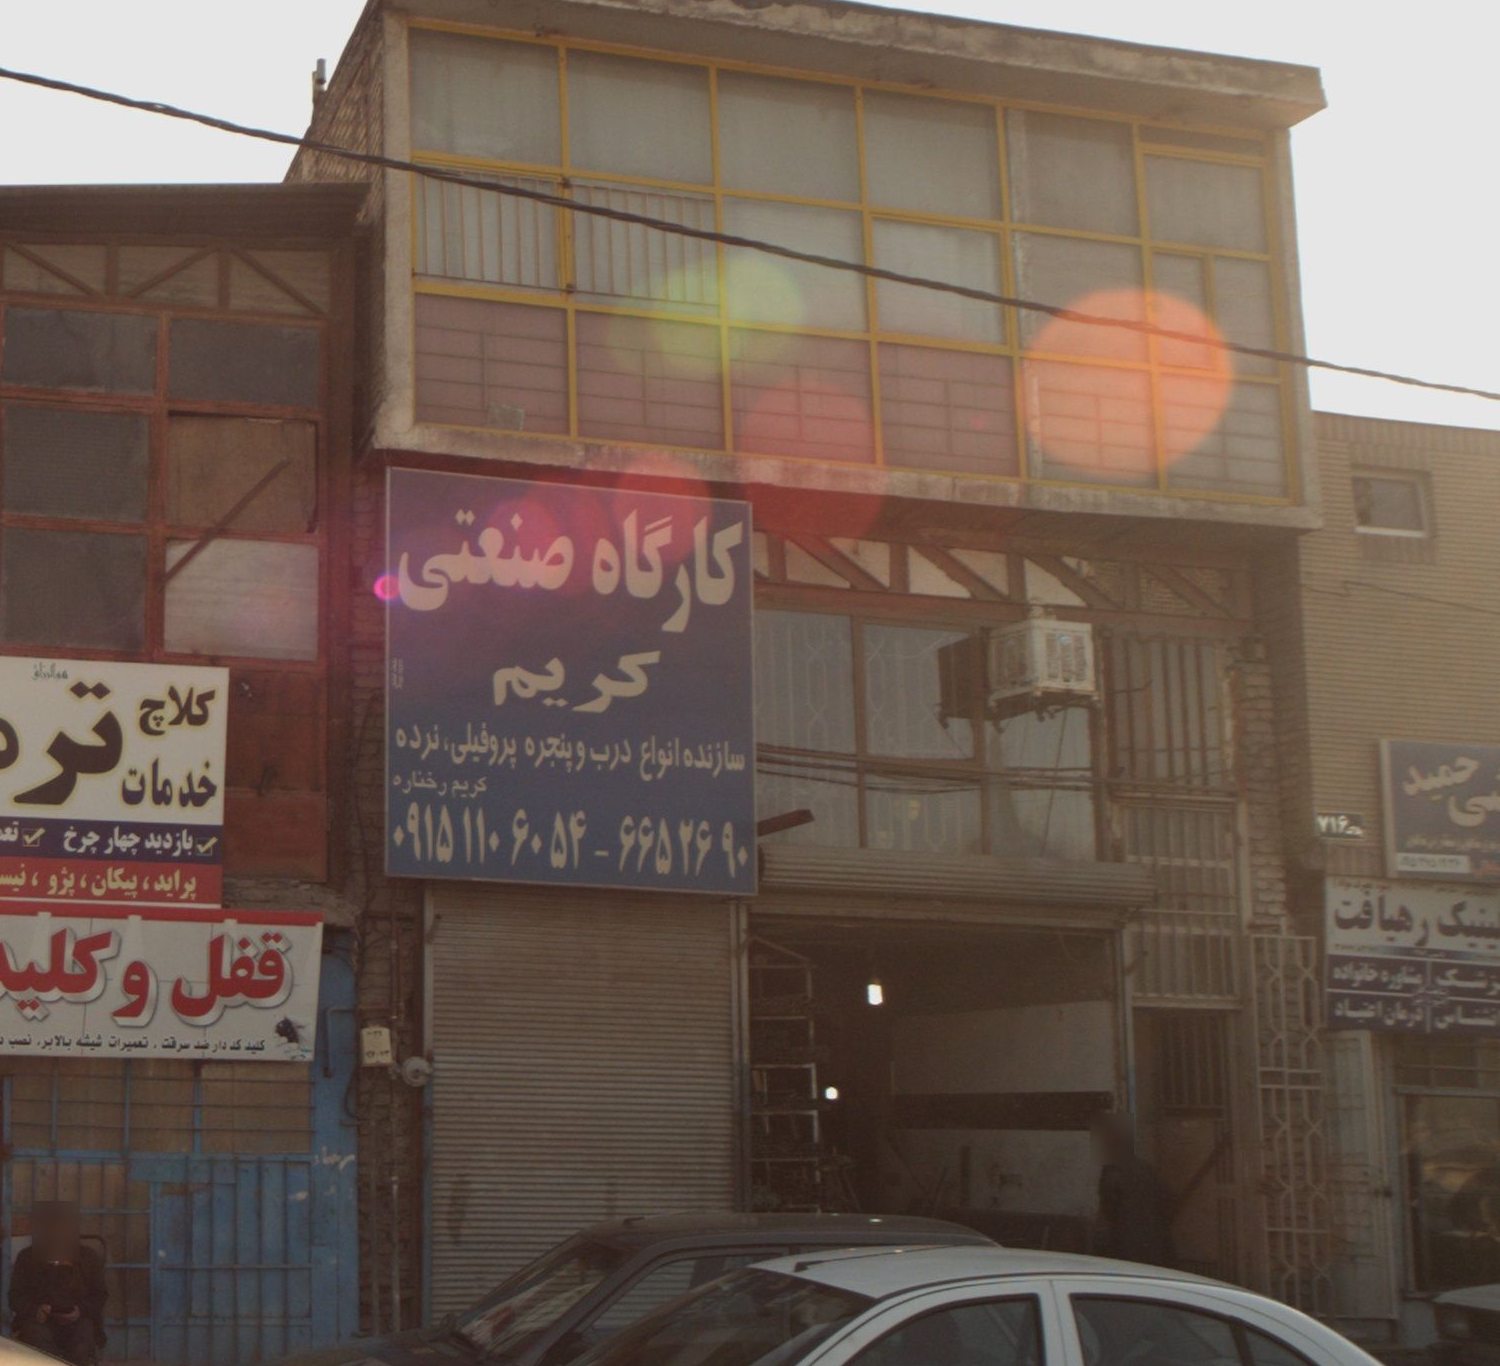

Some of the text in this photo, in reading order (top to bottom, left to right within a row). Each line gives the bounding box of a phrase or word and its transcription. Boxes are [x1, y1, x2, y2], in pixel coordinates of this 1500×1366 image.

[399, 509, 743, 633] کارگاه صنعتی
[492, 650, 661, 714] کریم
[139, 685, 216, 736] کلاچ
[395, 723, 440, 761] نرده
[590, 738, 633, 771] درب
[639, 736, 680, 782] انواع
[682, 738, 746, 778] سازنده
[121, 757, 218, 808] خدمات
[451, 775, 488, 798] کریم
[1401, 754, 1480, 800] حمید
[62, 826, 193, 857] بازدید چهار چرخ
[1334, 889, 1429, 947] رهیافت
[111, 960, 151, 1020] و
[171, 931, 287, 1019] قفل
[7, 1034, 33, 1048] نصب
[75, 1033, 103, 1048] شیشه
[108, 1035, 149, 1051] تعمیرات
